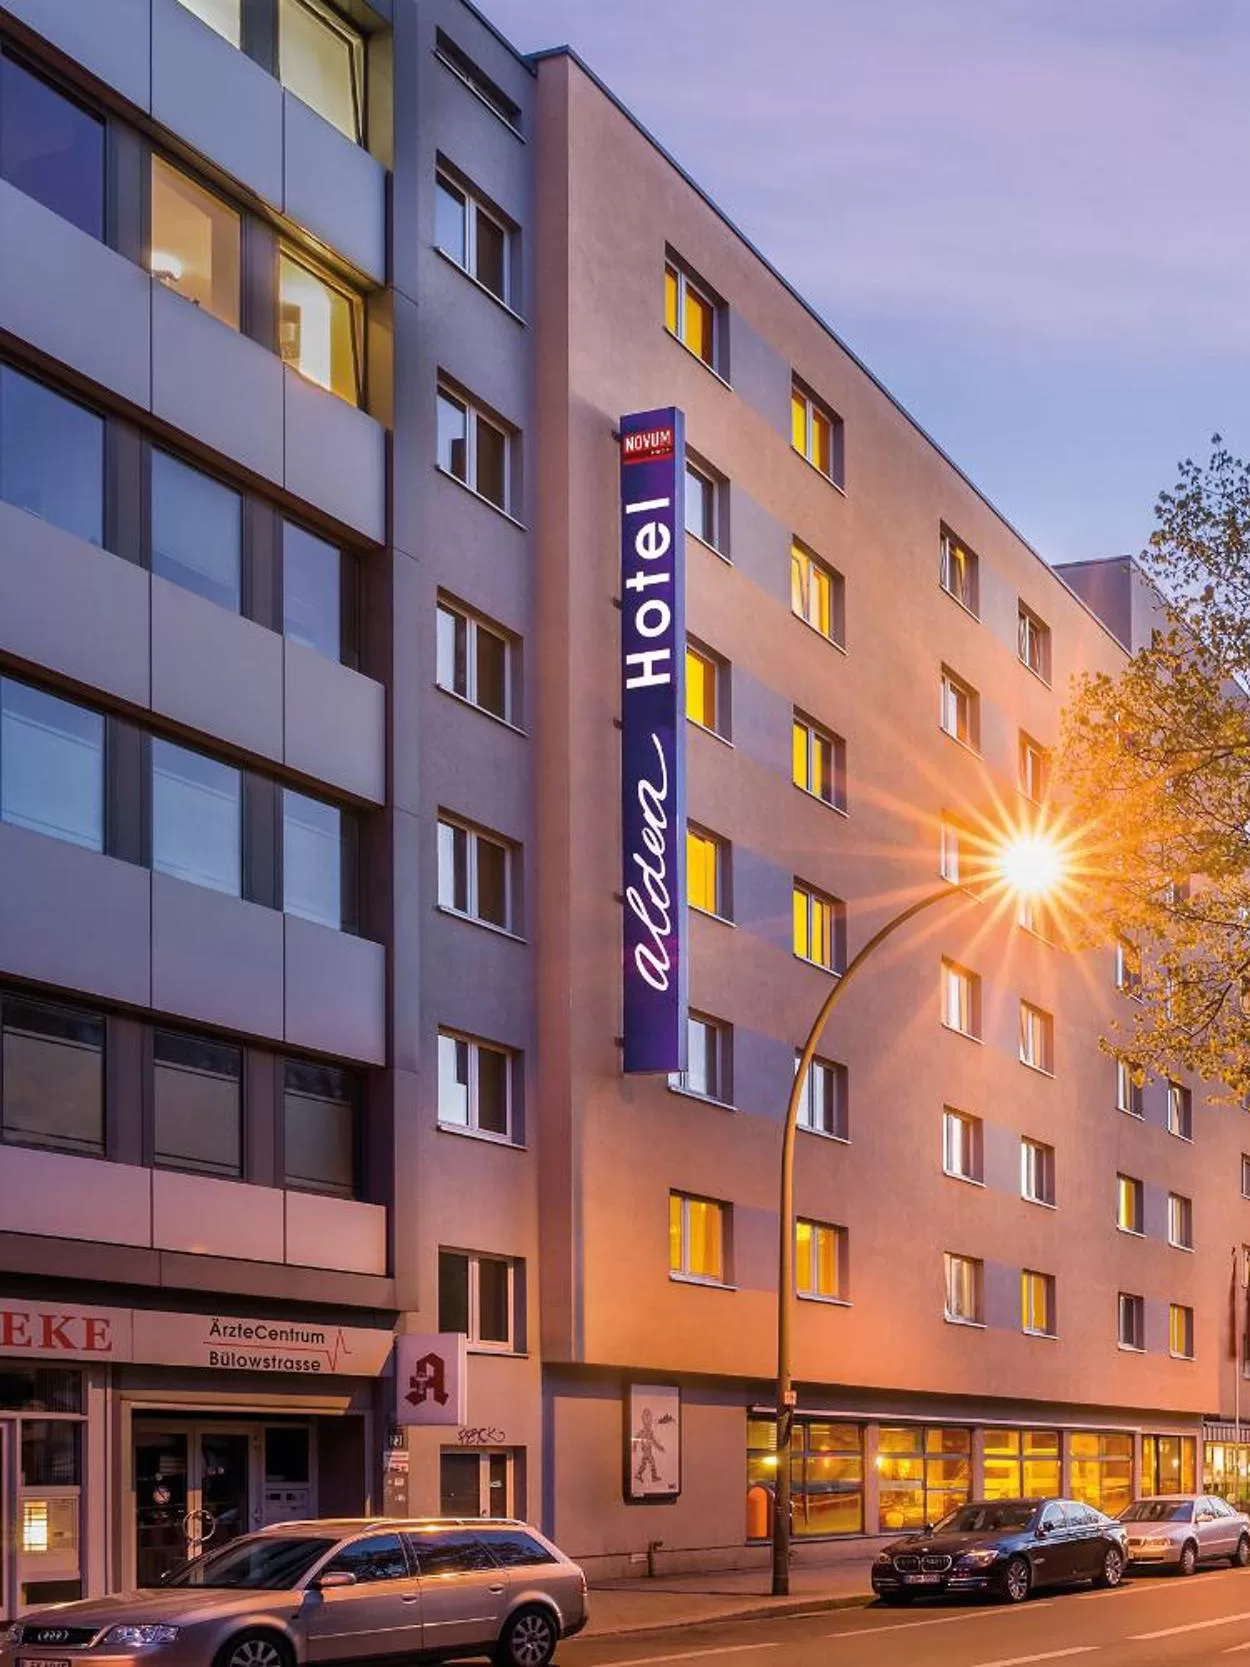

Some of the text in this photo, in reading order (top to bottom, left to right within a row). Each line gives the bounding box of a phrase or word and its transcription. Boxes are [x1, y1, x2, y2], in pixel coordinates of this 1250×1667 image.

[625, 430, 671, 453] NOVUM
[626, 497, 671, 690] Hotel
[626, 732, 672, 992] aldea
[0, 1311, 112, 1352] EKE
[209, 1318, 325, 1344] ÄrzteCentrum
[209, 1350, 321, 1372] Bülowstrasse
